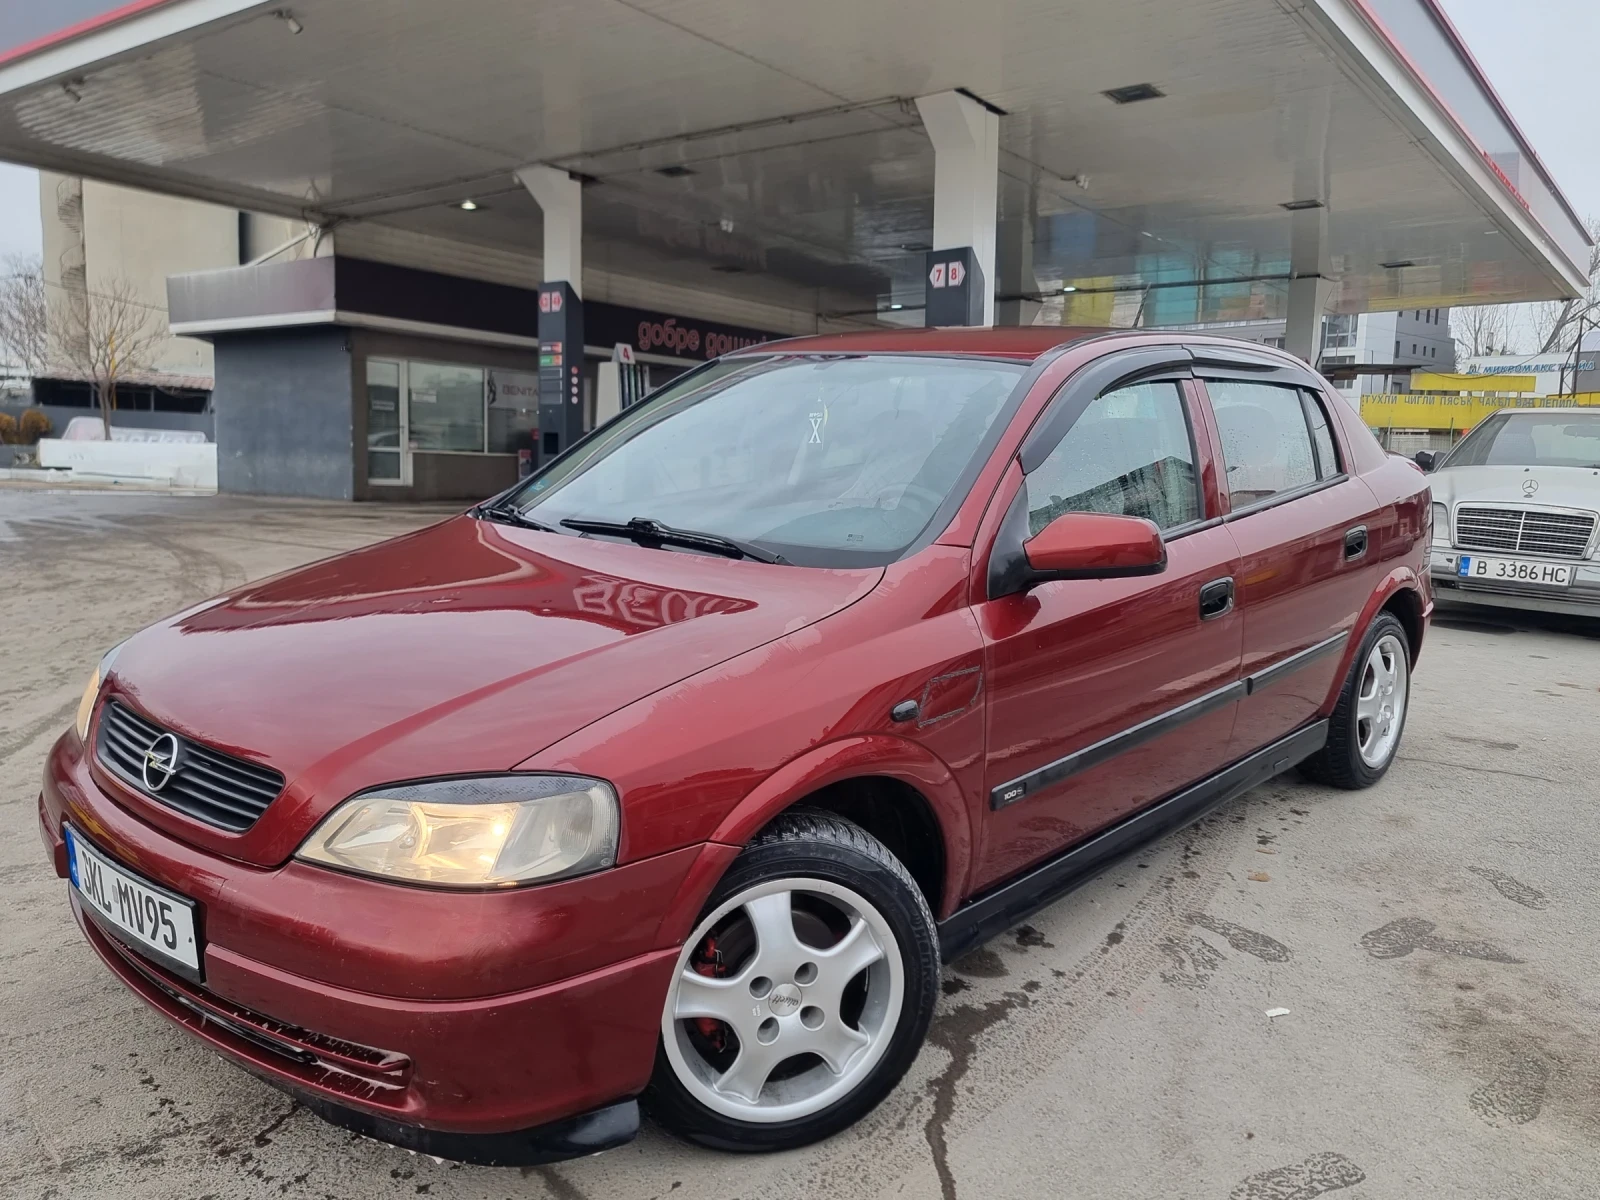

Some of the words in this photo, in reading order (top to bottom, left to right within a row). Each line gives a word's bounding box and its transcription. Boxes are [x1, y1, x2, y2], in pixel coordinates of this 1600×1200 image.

[935, 269, 942, 282] 7
[951, 268, 957, 280] 8
[638, 318, 699, 355] добре
[623, 347, 630, 361] 4
[1365, 395, 1397, 405] ТУХЛИ
[1404, 396, 1435, 405] ЦИГЛИ
[1440, 396, 1472, 406] ПЯСЪК
[1478, 396, 1511, 407] ЧАКЪЛ
[1476, 561, 1487, 575] B
[1496, 563, 1538, 580] 3386
[1542, 566, 1567, 583] HC
[82, 850, 112, 914] SKL
[116, 878, 177, 950] MV95
